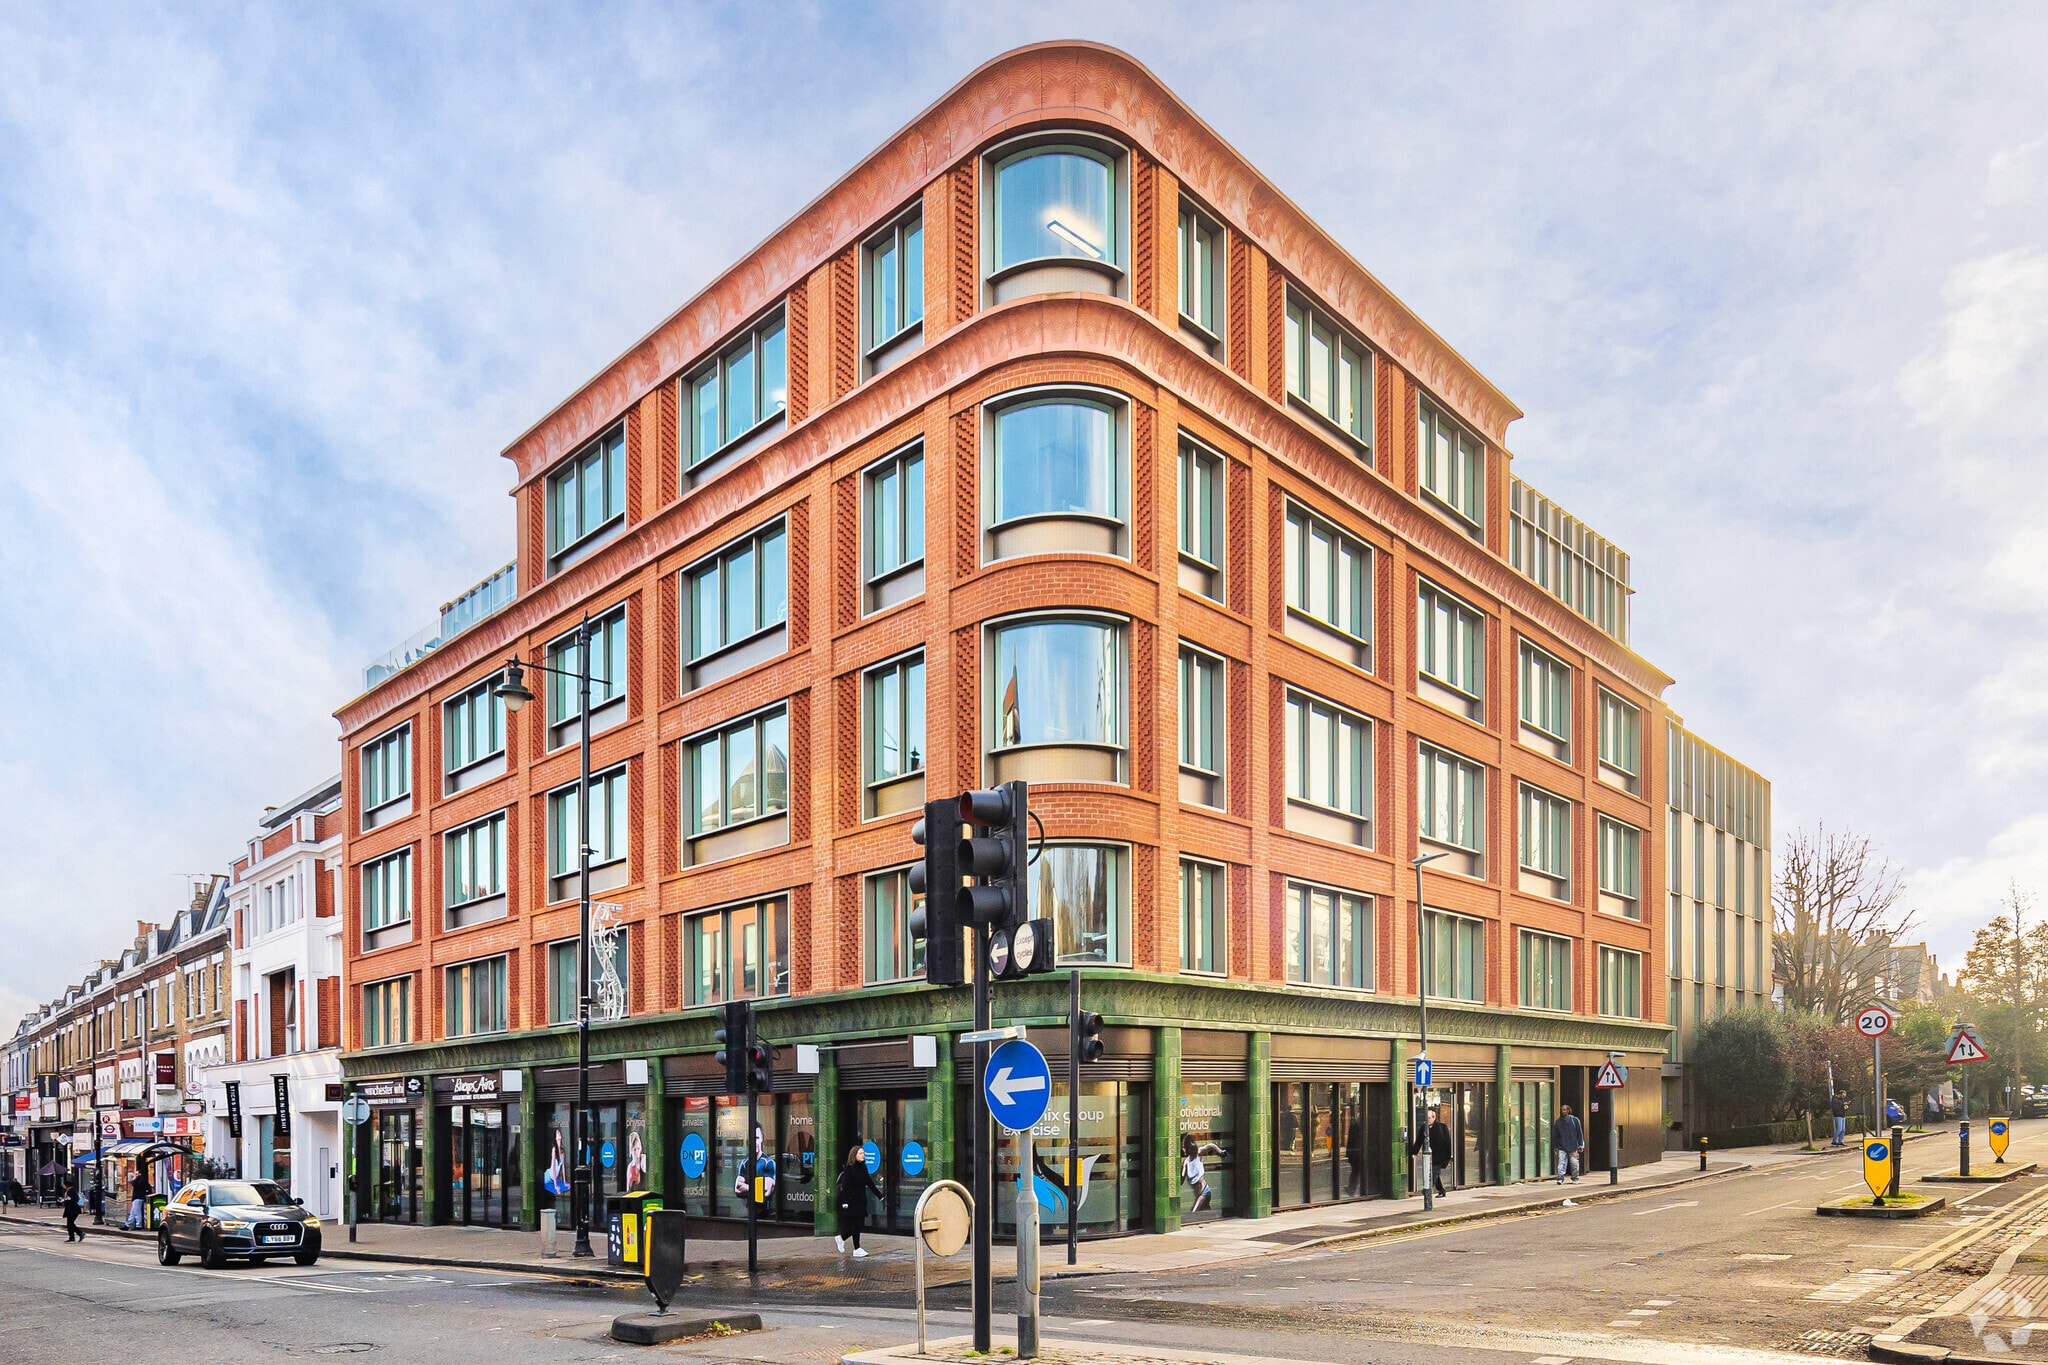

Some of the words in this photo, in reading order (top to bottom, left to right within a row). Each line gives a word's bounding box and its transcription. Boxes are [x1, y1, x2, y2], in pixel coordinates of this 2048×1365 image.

[1861, 1016, 1887, 1029] 20
[364, 1085, 393, 1096] winchester
[394, 1083, 405, 1094] whi
[1063, 1110, 1105, 1124] goup
[1180, 1105, 1220, 1118] otivational
[682, 1117, 704, 1128] private
[790, 1115, 813, 1126] home
[1180, 1118, 1209, 1131] orkouts
[1003, 1123, 1060, 1136] excise
[682, 1150, 705, 1160] DNPT
[786, 1191, 815, 1202] outdoo
